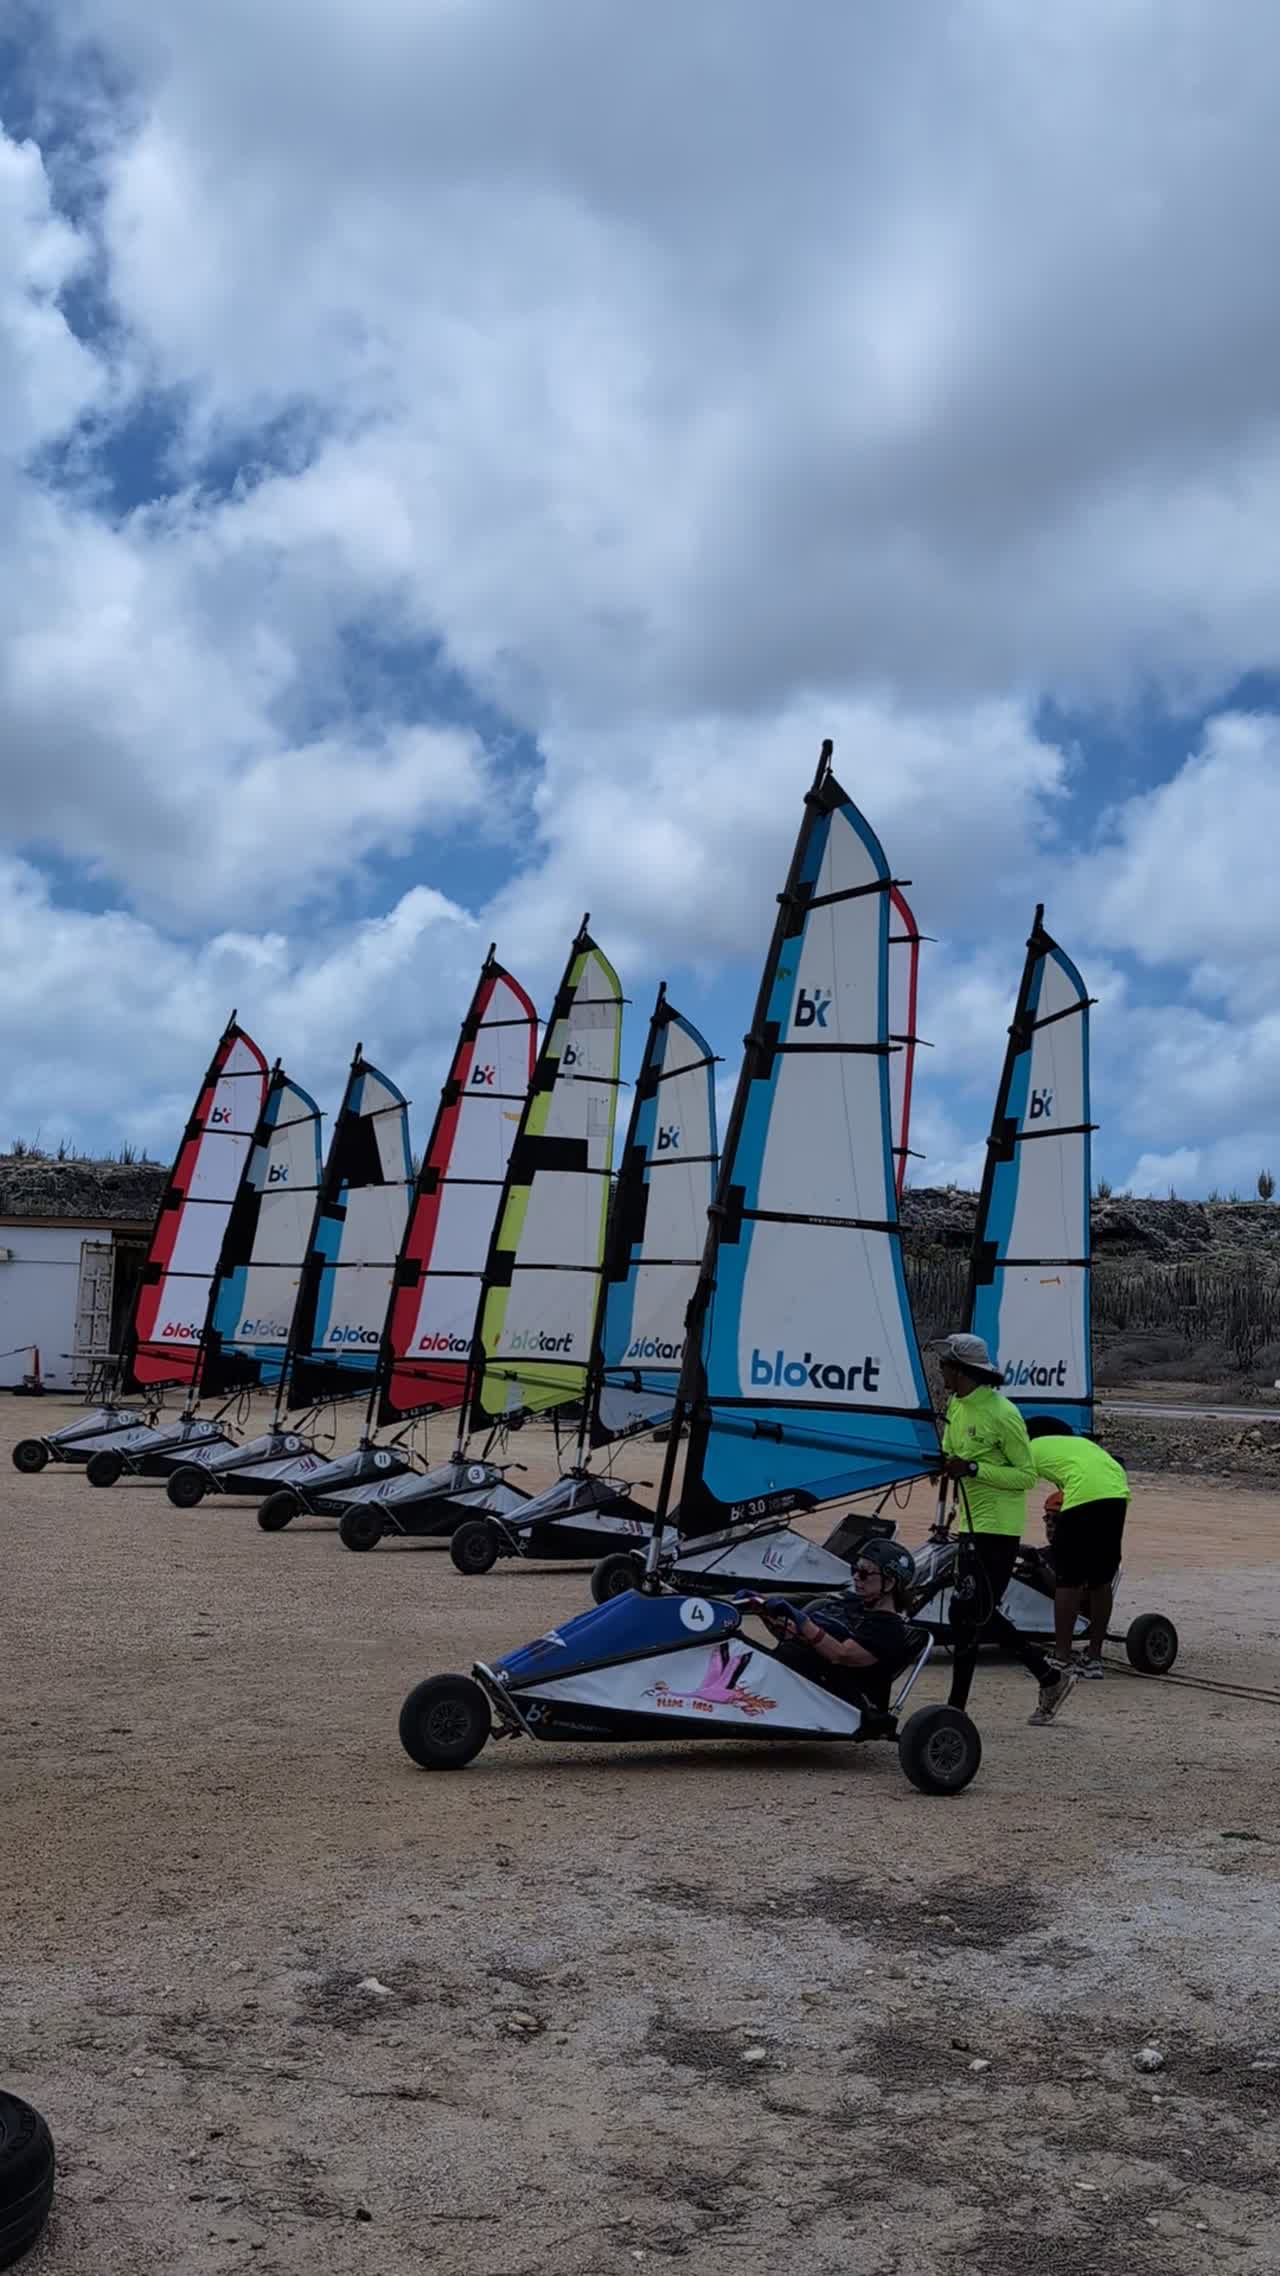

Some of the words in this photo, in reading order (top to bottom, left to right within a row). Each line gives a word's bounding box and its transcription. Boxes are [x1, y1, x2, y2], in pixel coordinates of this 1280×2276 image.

[241, 1320, 287, 1338] bloka
[419, 1333, 472, 1353] blokar
[511, 1331, 574, 1352] blokart
[628, 1338, 682, 1359] blokar
[751, 1349, 880, 1392] blokart
[1004, 1360, 1066, 1386] blokart
[749, 1499, 766, 1516] 3.0
[691, 1604, 705, 1622] 4
